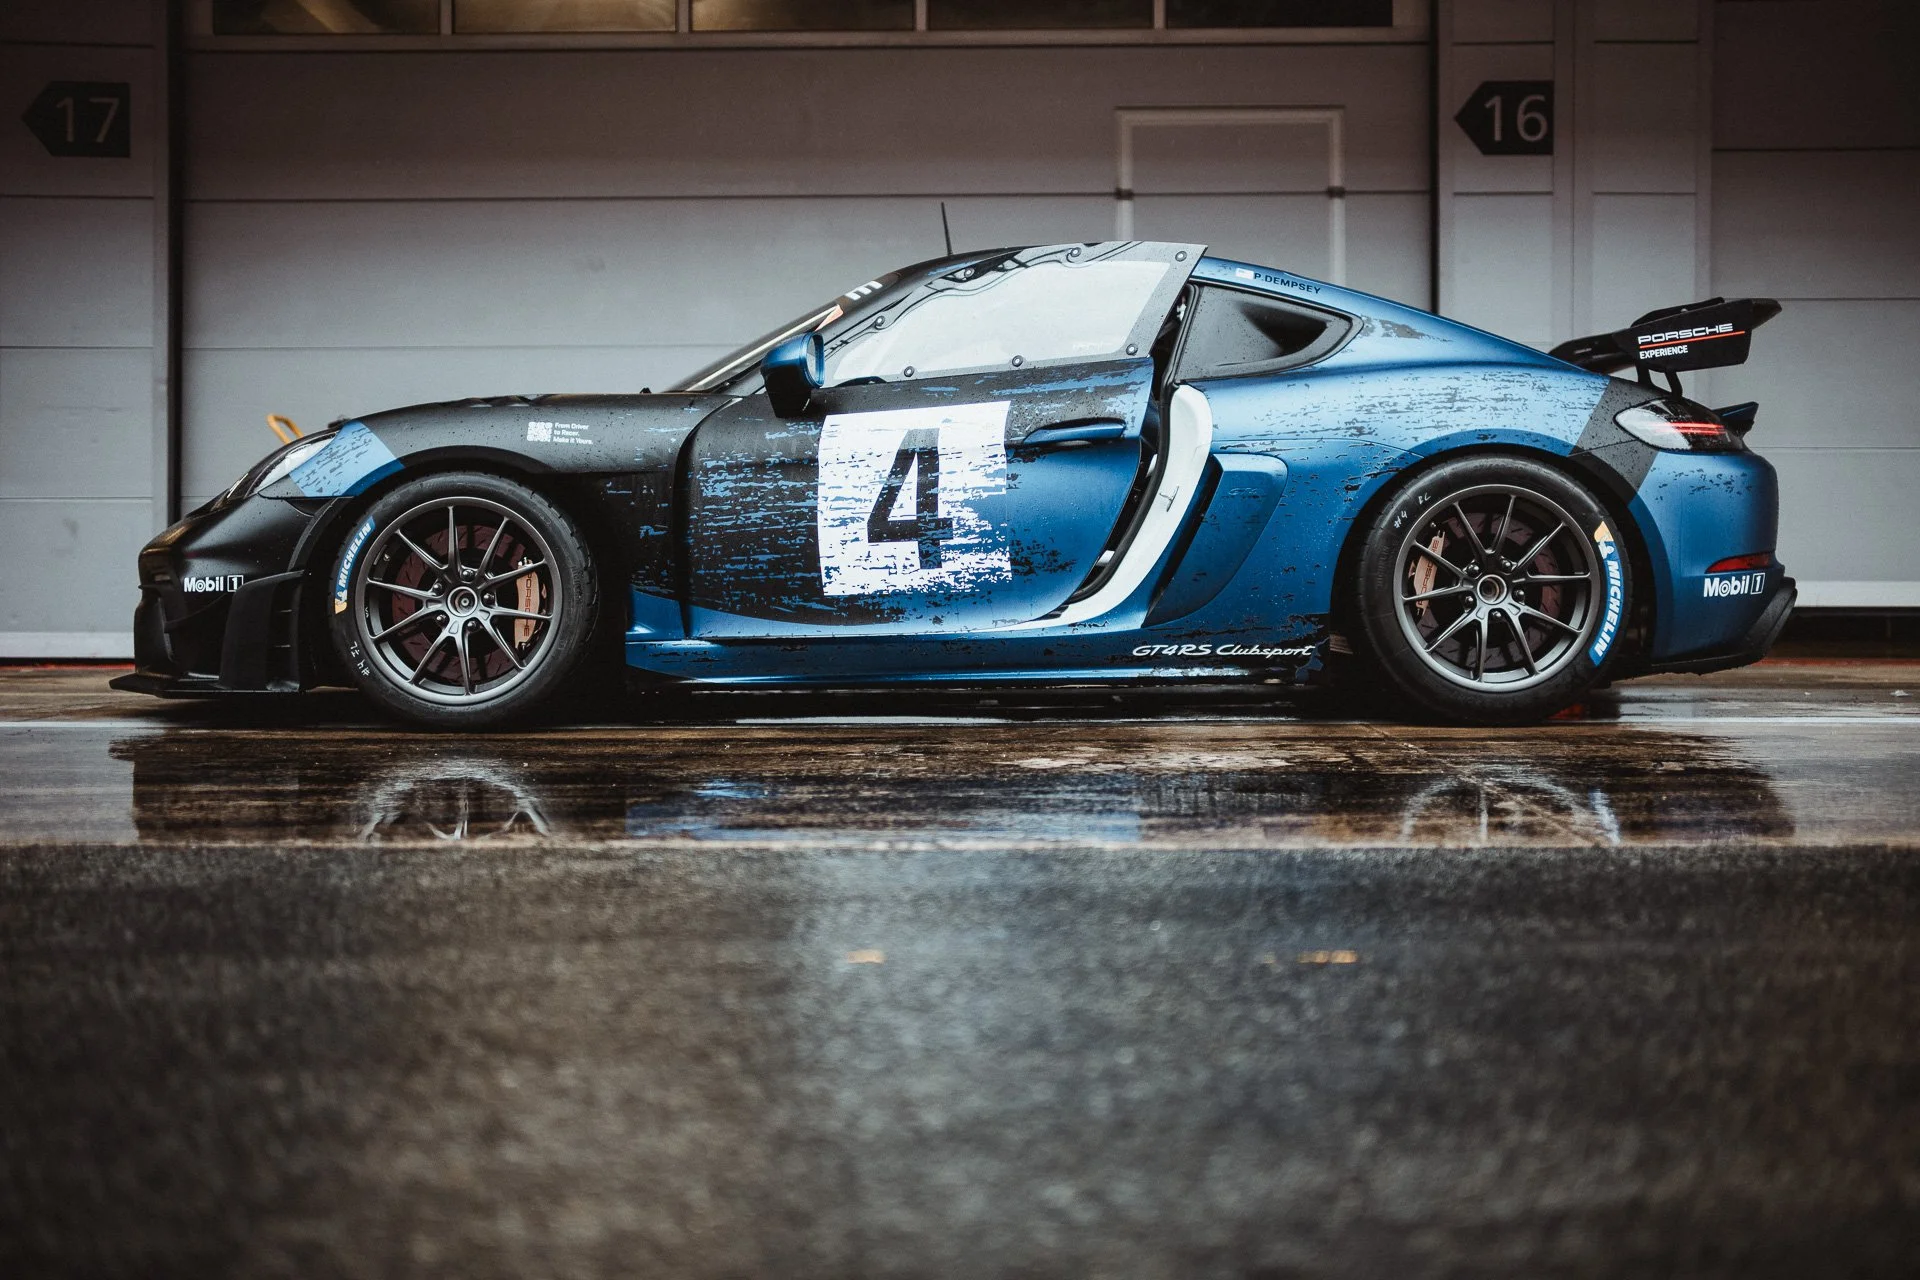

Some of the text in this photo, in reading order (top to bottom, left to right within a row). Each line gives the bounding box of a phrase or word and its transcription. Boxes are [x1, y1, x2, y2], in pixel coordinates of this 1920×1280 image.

[56, 97, 119, 143] 17
[1484, 95, 1548, 142] 16
[1254, 272, 1321, 294] P.DEMPSEY
[1638, 323, 1733, 344] PORSCHE
[1639, 345, 1689, 359] EXPERIENCE
[867, 428, 953, 569] 4
[338, 522, 372, 588] MICHELIN
[184, 576, 224, 592] Mobil
[1703, 575, 1750, 597] Mobil
[1594, 560, 1621, 657] MICHELIN
[1132, 644, 1315, 659] GT4RS Clubsport
